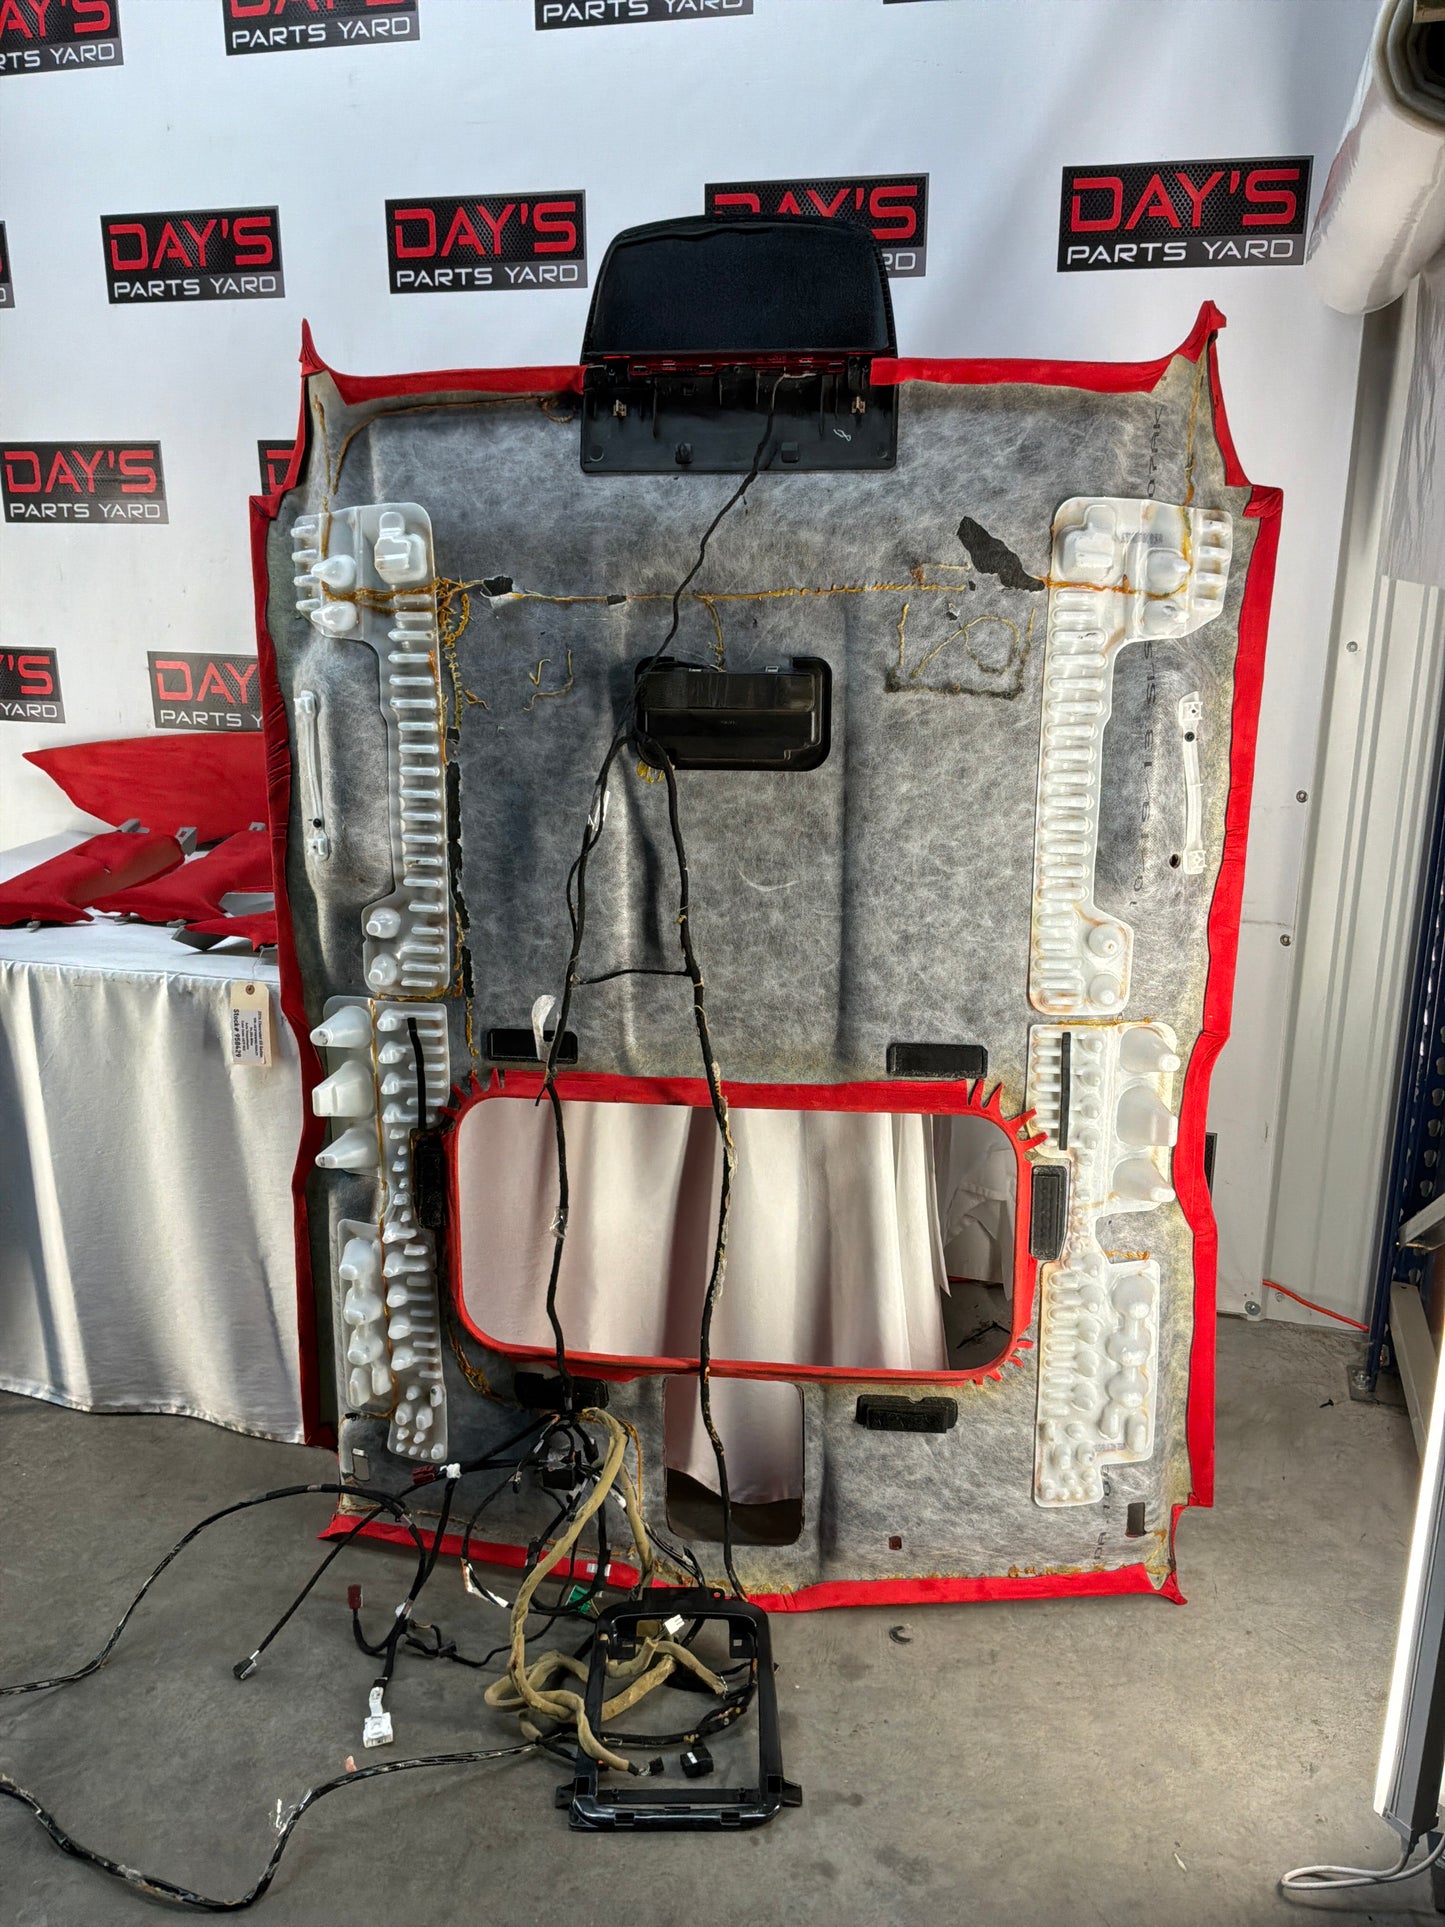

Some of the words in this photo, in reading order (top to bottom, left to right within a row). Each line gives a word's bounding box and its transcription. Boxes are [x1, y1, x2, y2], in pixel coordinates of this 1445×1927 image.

[543, 0, 649, 23] PARTS
[232, 24, 326, 48] PARTS
[338, 17, 410, 39] YARD
[49, 43, 115, 65] YARD
[1070, 168, 1300, 232] DAY'S
[394, 201, 577, 259] DAY'S
[108, 216, 273, 271] DAY'S
[1066, 242, 1188, 265] PARTS
[1202, 239, 1294, 260] YARD
[114, 279, 200, 298] PARTS
[210, 276, 277, 295] YARD
[396, 267, 493, 288] PARTS
[504, 264, 579, 284] YARD
[4, 450, 157, 493] DAY'S
[9, 503, 90, 518] PARTS
[98, 503, 161, 519] YARD
[0, 702, 57, 718] YARD
[160, 709, 242, 727] PARTS
